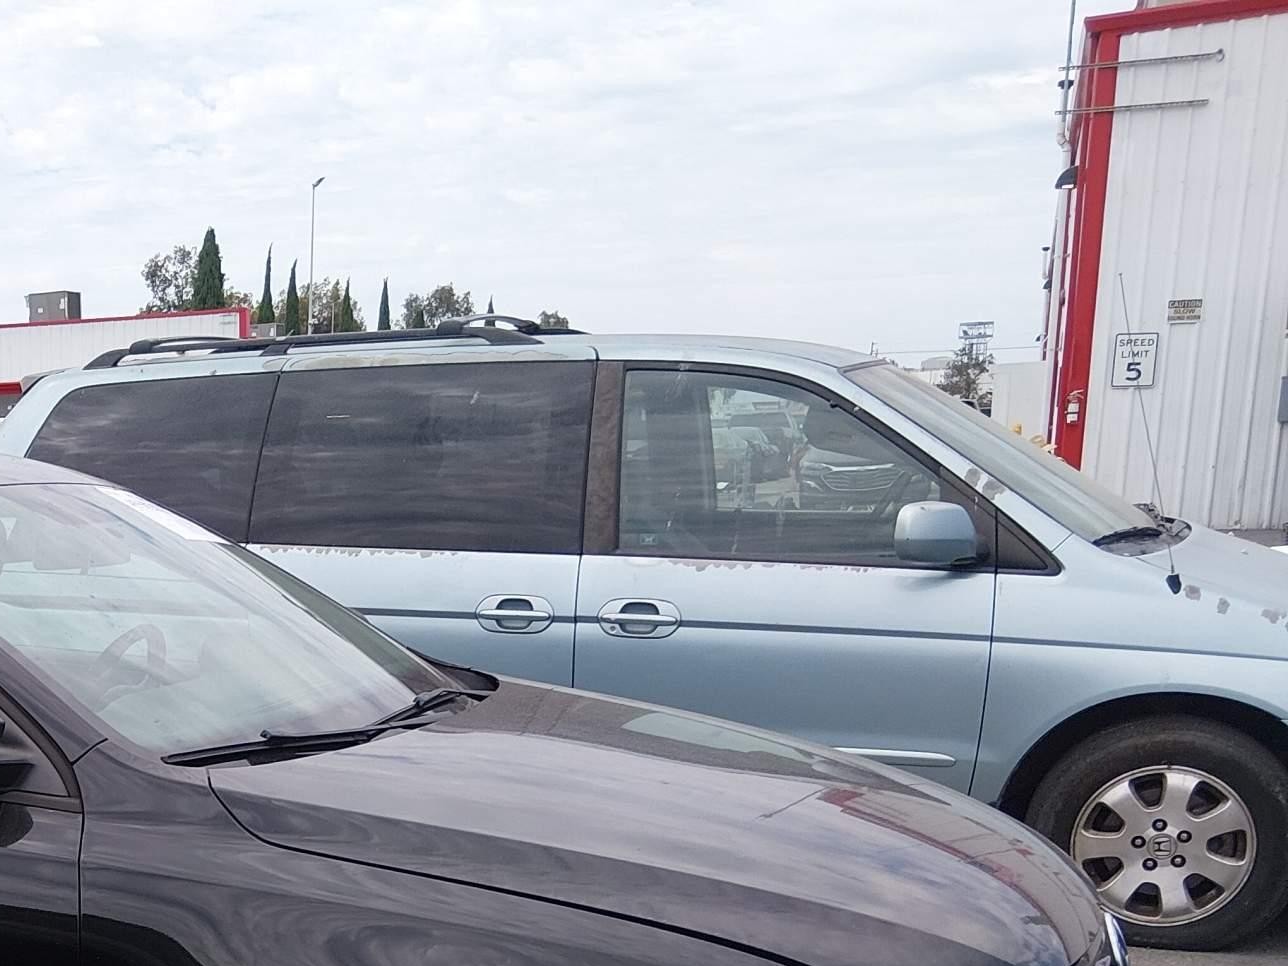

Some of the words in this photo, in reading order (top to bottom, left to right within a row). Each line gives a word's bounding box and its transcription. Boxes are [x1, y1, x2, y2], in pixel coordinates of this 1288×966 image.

[1169, 300, 1202, 308] CAUTION
[1119, 338, 1154, 347] SPEED
[1121, 350, 1150, 358] LIMIT
[1125, 362, 1142, 381] 5
